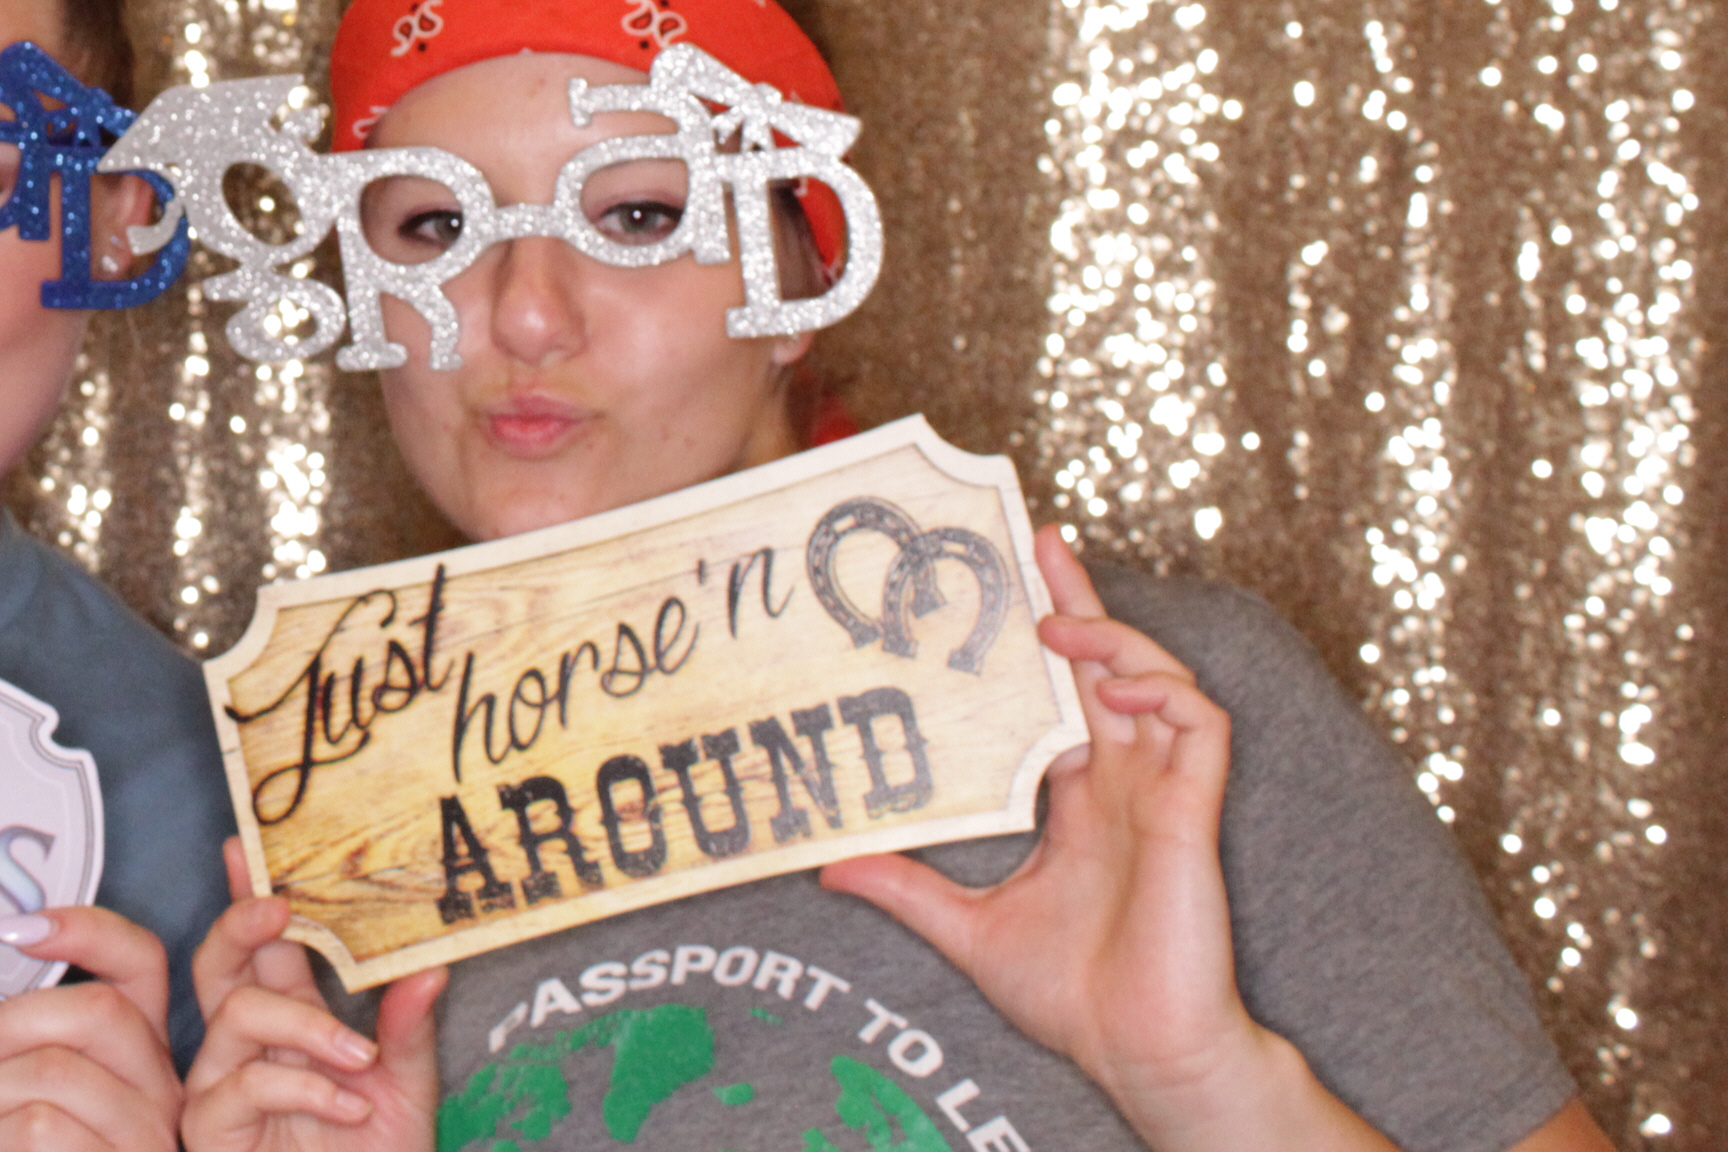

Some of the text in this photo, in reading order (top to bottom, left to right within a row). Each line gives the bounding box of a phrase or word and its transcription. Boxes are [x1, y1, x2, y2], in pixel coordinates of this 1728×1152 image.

[223, 545, 797, 827] Just horse'n
[436, 686, 935, 925] AROUND
[857, 997, 944, 1078] TO
